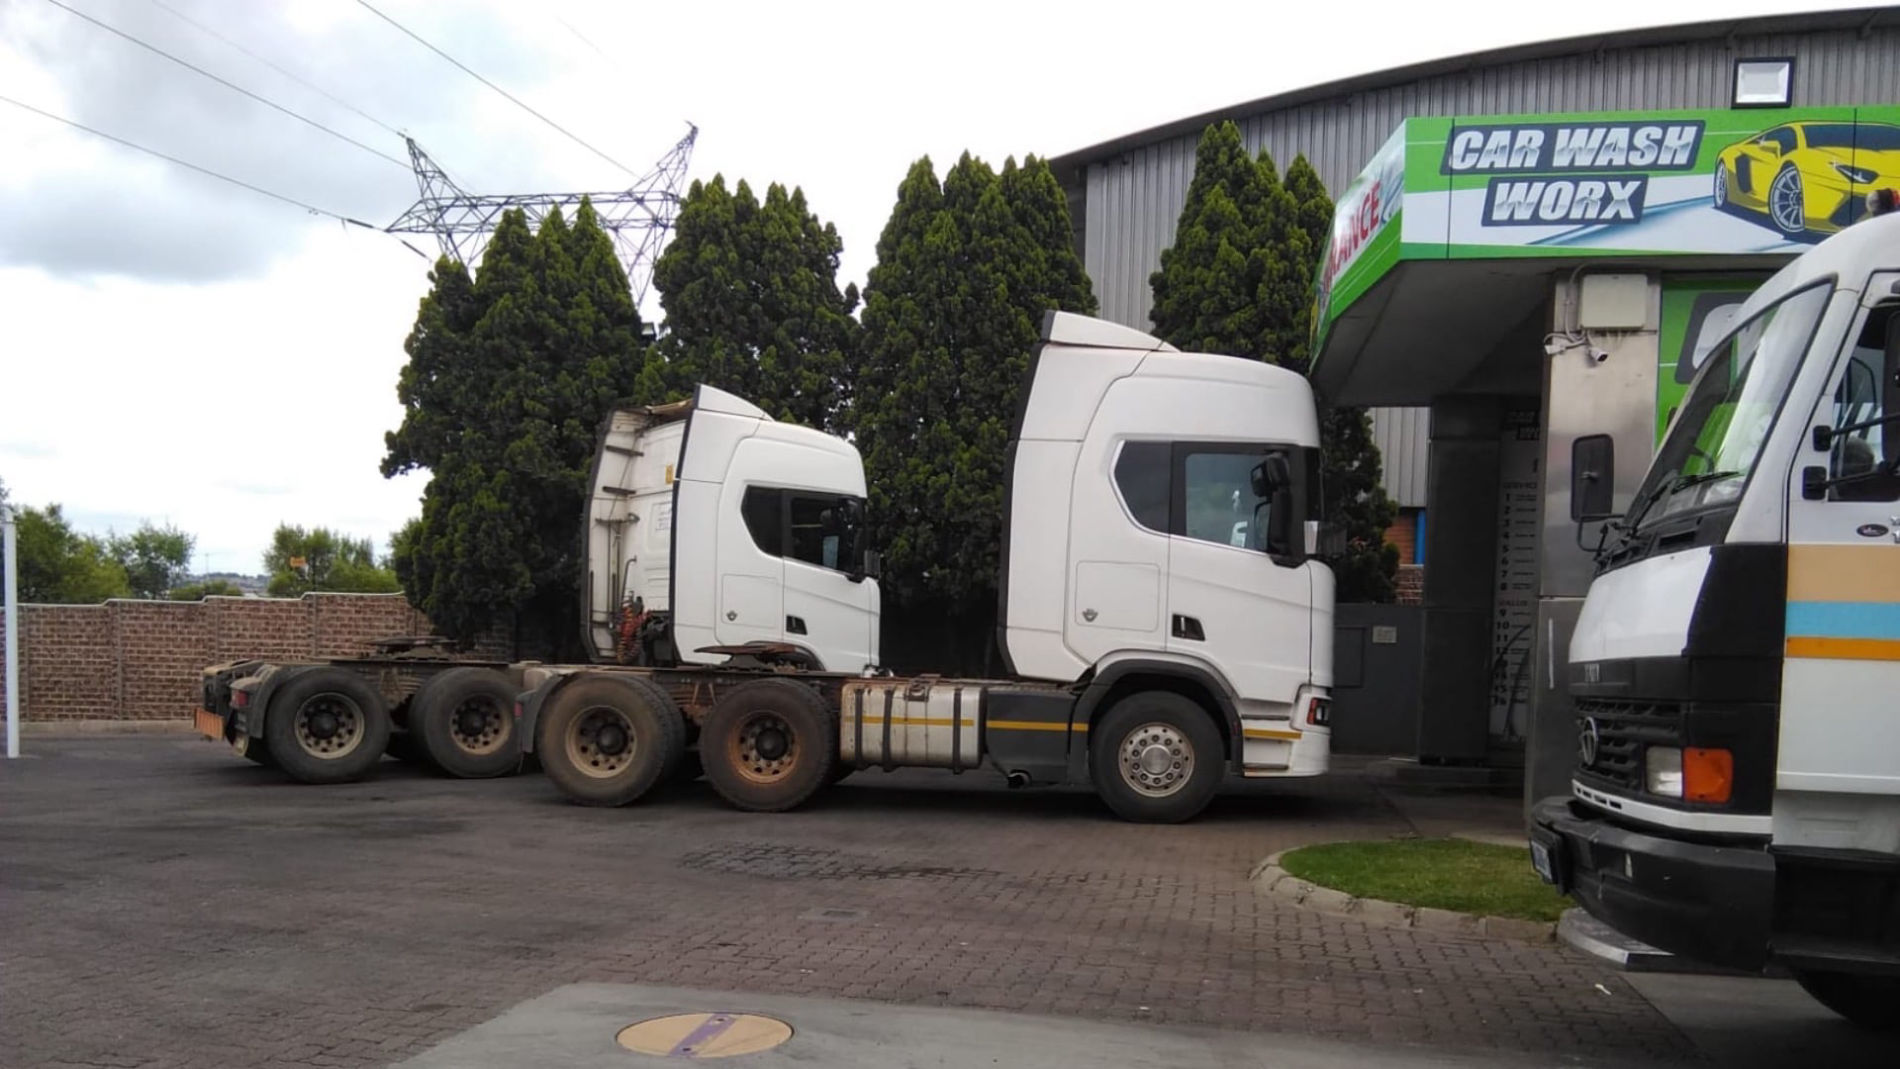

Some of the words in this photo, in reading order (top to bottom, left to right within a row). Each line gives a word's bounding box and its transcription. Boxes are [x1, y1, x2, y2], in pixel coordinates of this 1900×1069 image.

[1450, 129, 1545, 170] CAR
[1552, 126, 1698, 168] WASH
[1491, 180, 1642, 221] WORX
